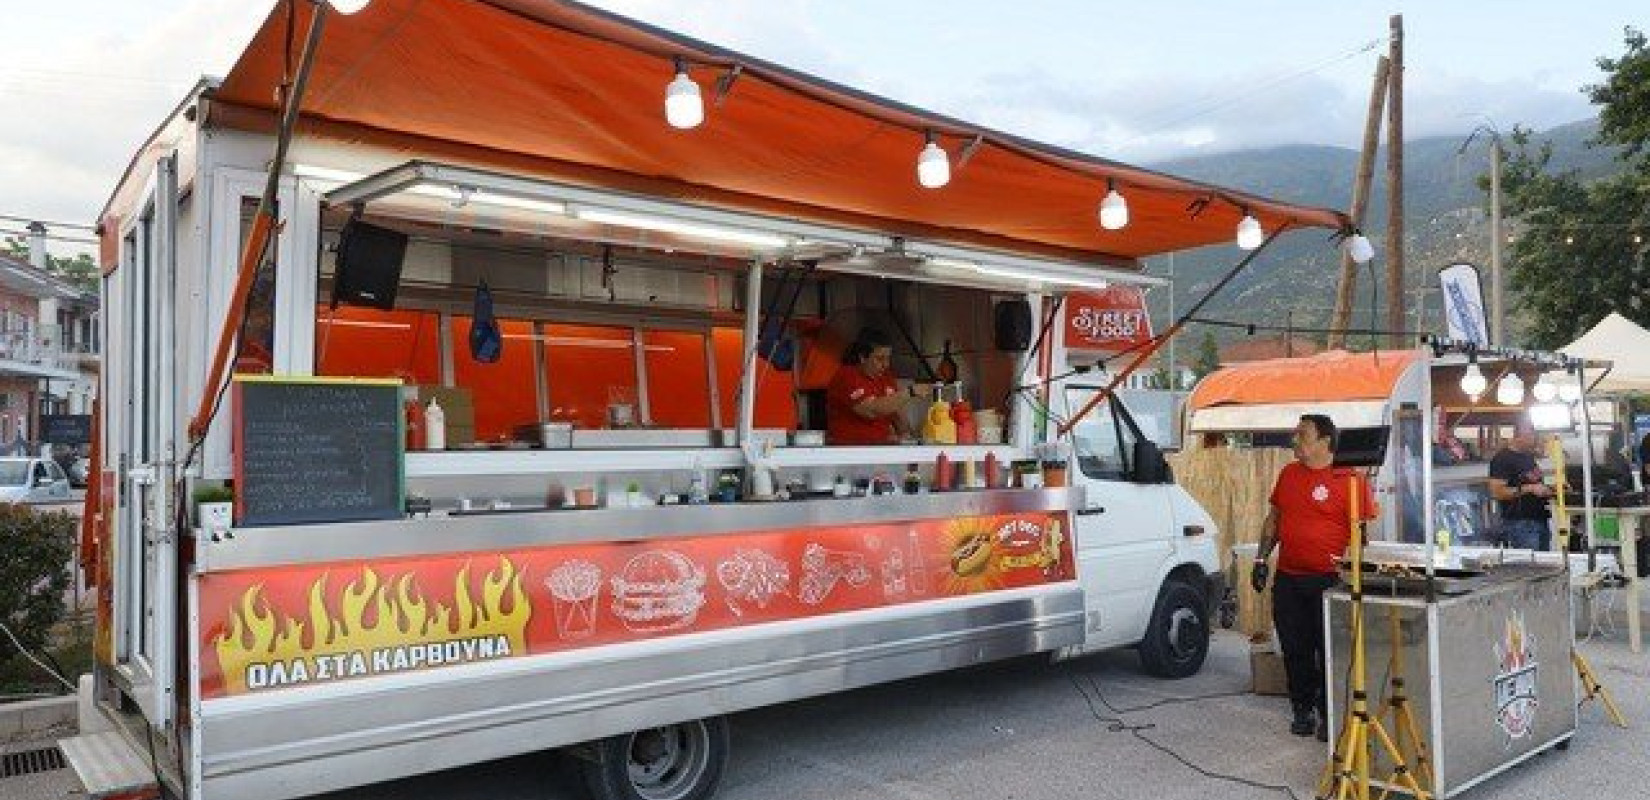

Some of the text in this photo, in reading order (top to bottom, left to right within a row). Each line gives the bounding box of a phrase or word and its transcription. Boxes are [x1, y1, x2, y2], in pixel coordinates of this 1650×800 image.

[246, 634, 511, 688] ΟΛΑ ΣΤΑ ΚΑΡΒΟΥΝΑ
